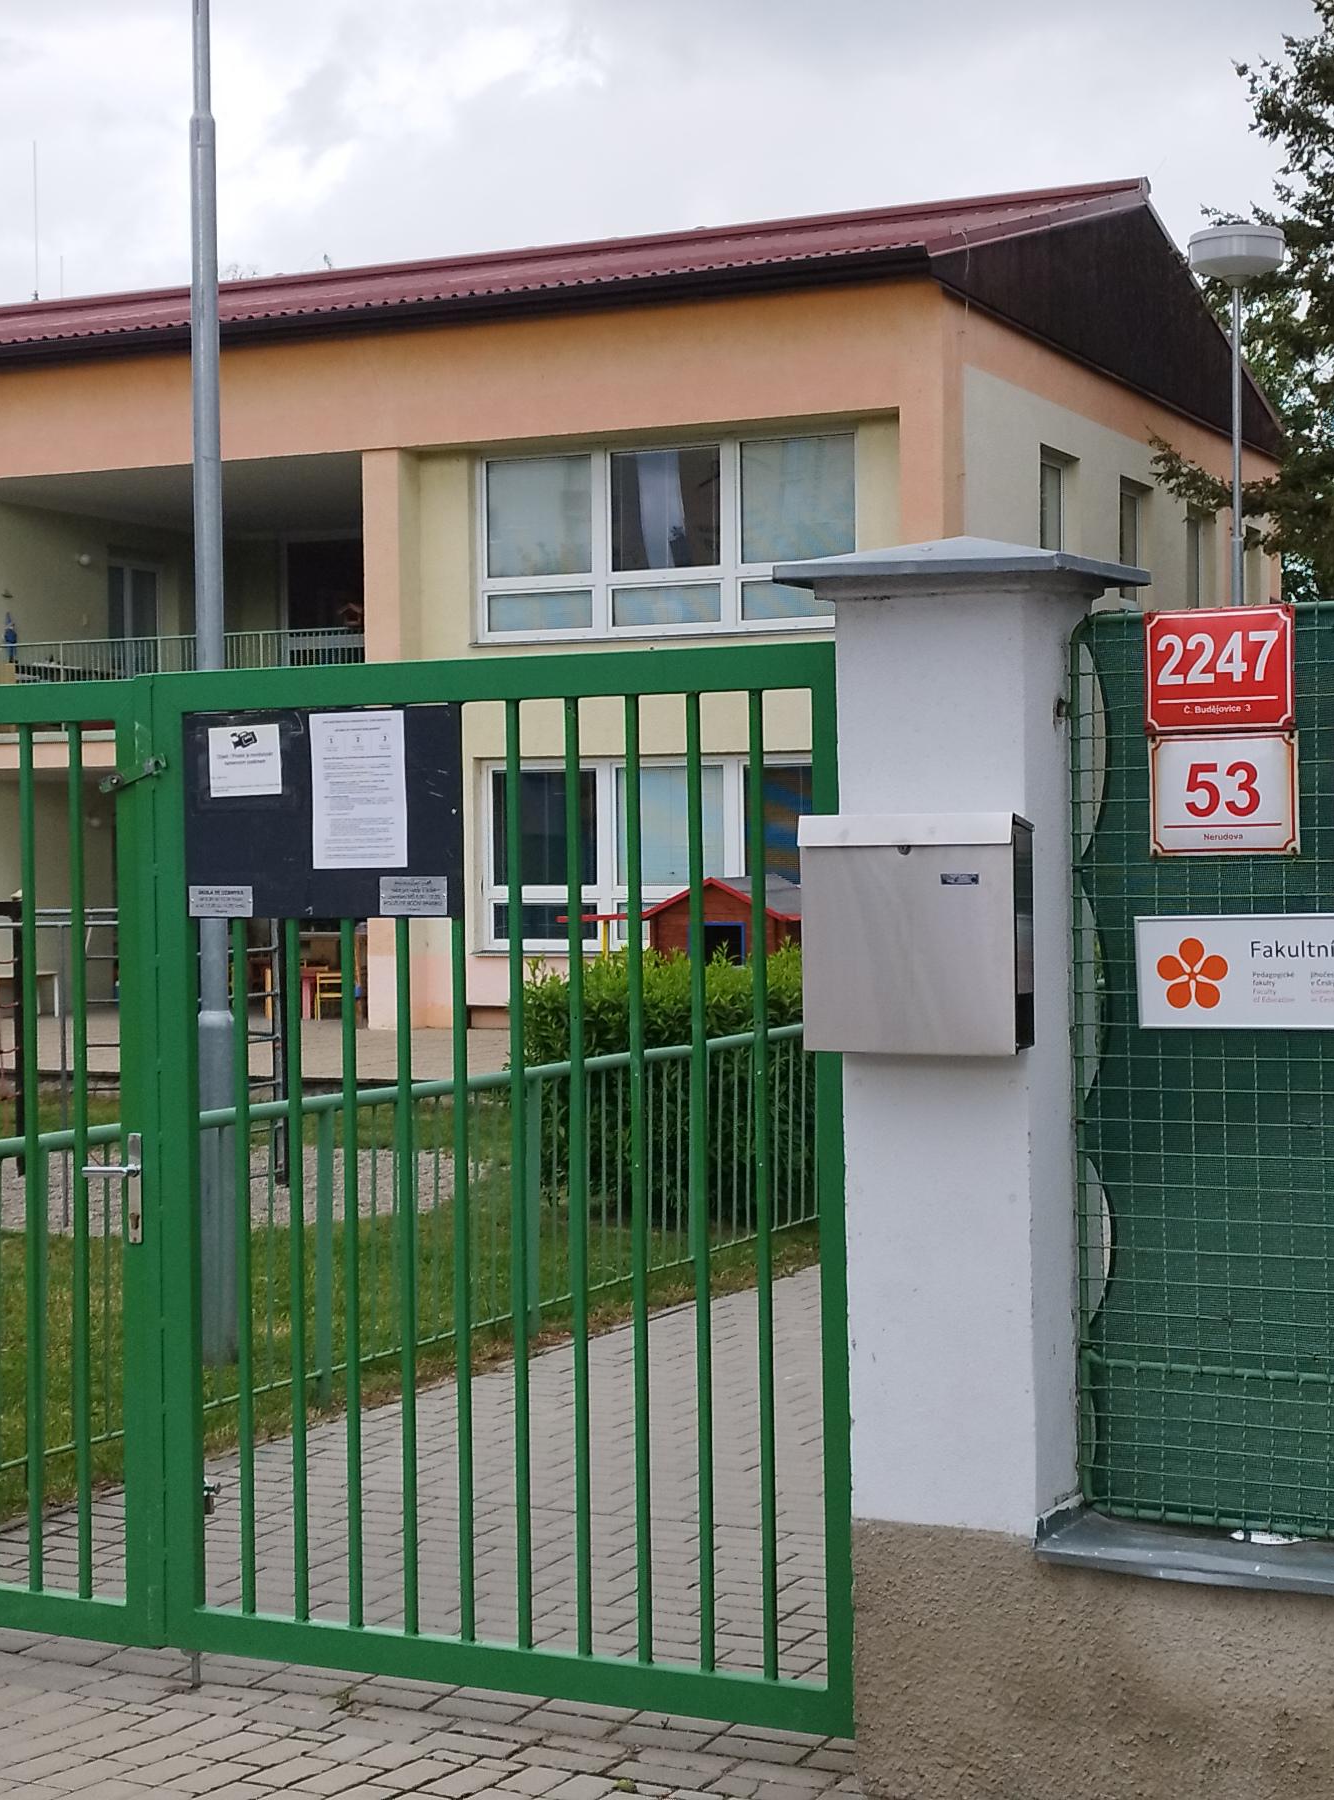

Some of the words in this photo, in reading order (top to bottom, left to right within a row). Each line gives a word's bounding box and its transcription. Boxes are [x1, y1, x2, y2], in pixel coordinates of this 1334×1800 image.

[1157, 630, 1279, 685] 2247
[1183, 704, 1193, 714] Č.
[1194, 705, 1242, 715] Budějovice
[1244, 704, 1252, 712] 3
[1185, 761, 1260, 817] 53
[1203, 833, 1244, 842] Nerudova
[1250, 940, 1334, 958] Fakultní
[1252, 979, 1276, 988] fakulty
